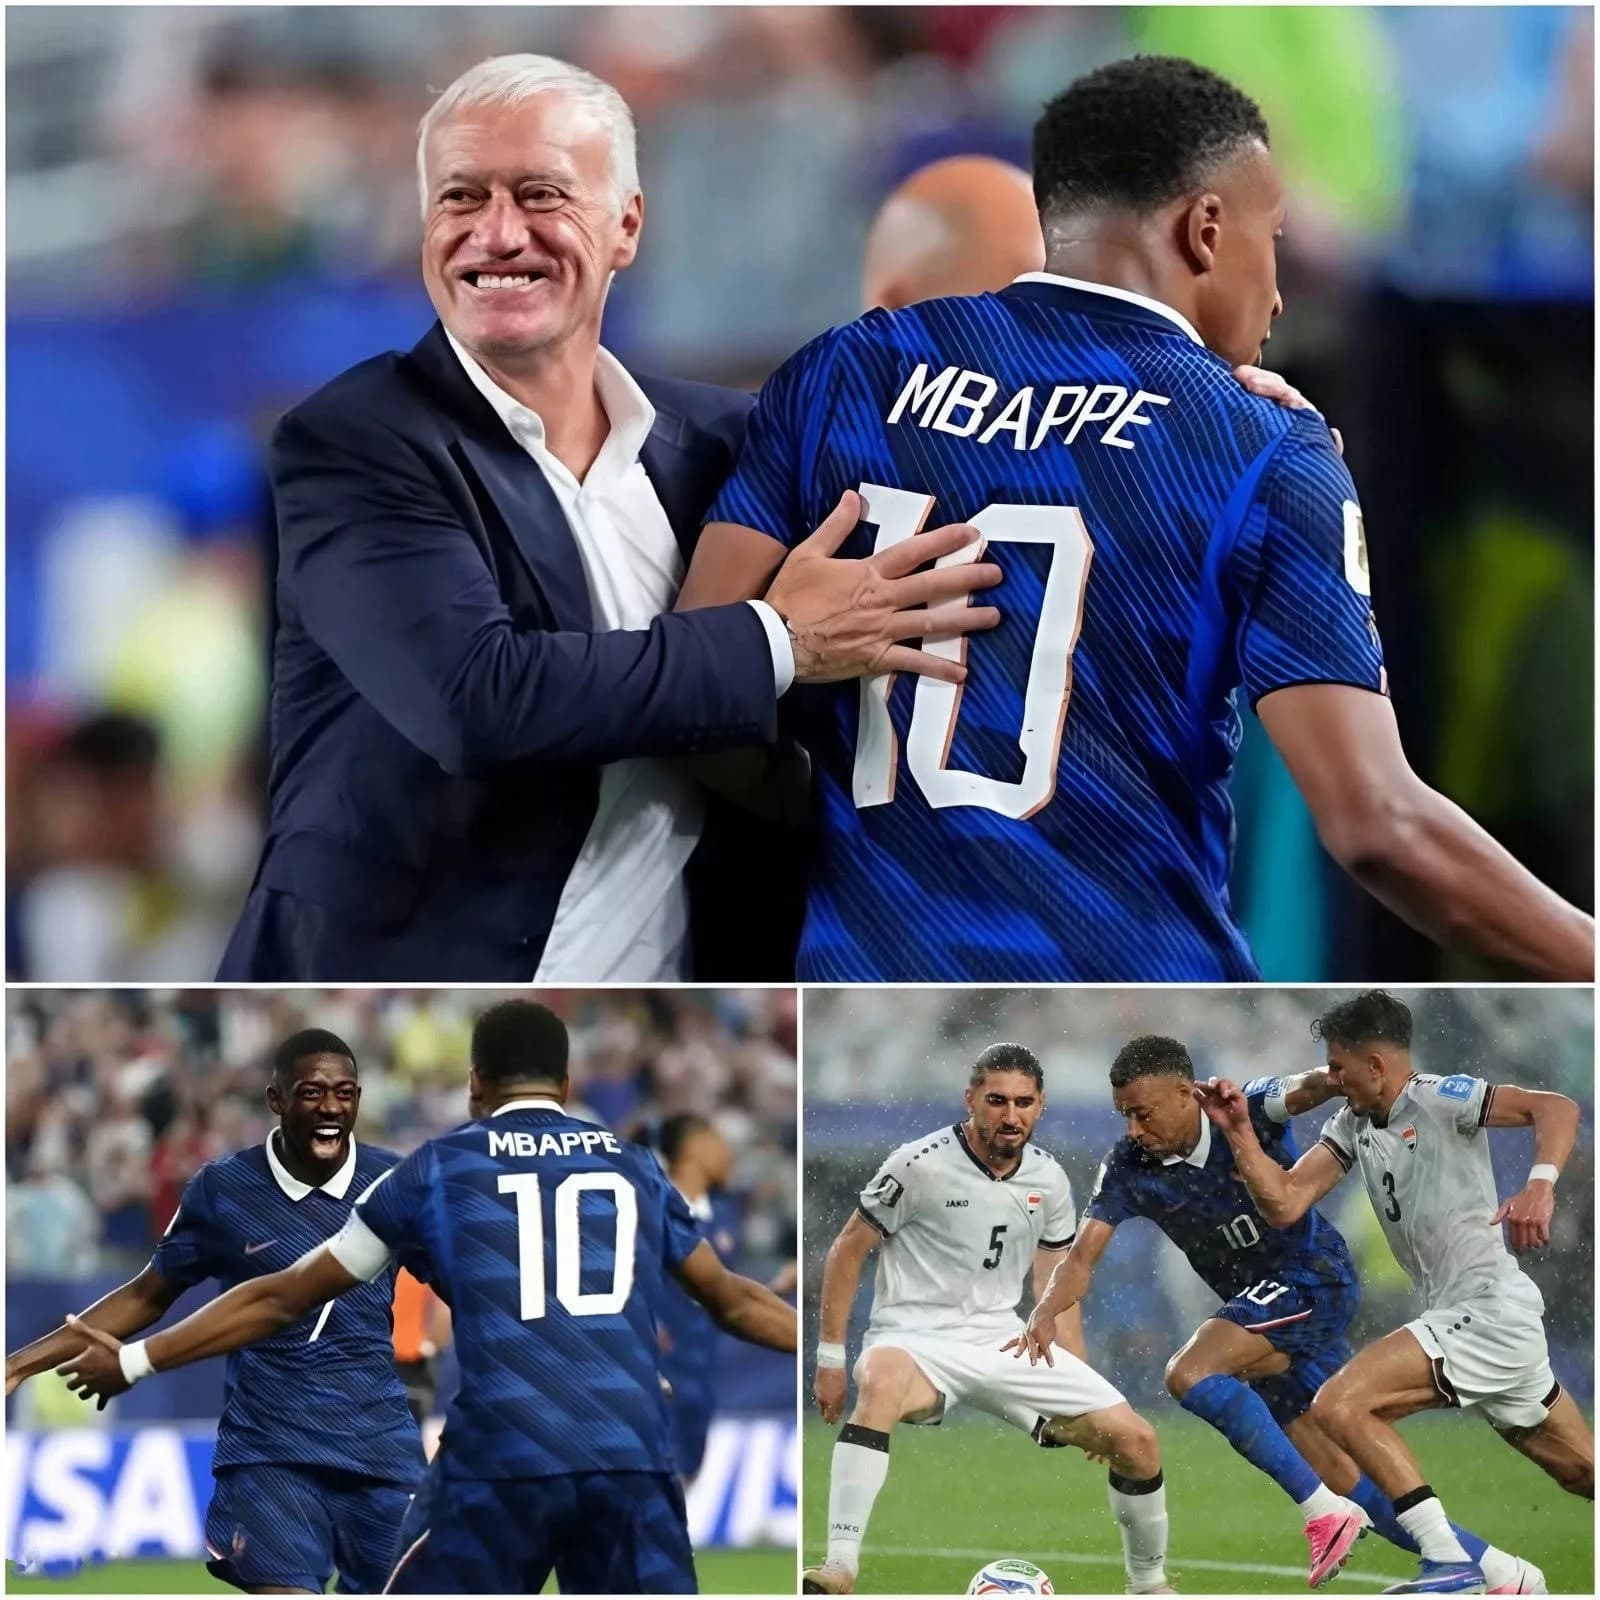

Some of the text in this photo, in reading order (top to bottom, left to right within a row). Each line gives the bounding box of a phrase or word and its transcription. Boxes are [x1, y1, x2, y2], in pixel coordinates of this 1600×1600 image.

[887, 363, 1171, 450] MBAPPE
[853, 482, 1095, 821] 10
[488, 1130, 622, 1157] MBAPPE
[944, 1199, 969, 1208] JAKO
[1382, 1171, 1402, 1222] 3
[497, 1171, 638, 1321] 10
[982, 1225, 1008, 1270] 5
[1216, 1214, 1260, 1249] 10
